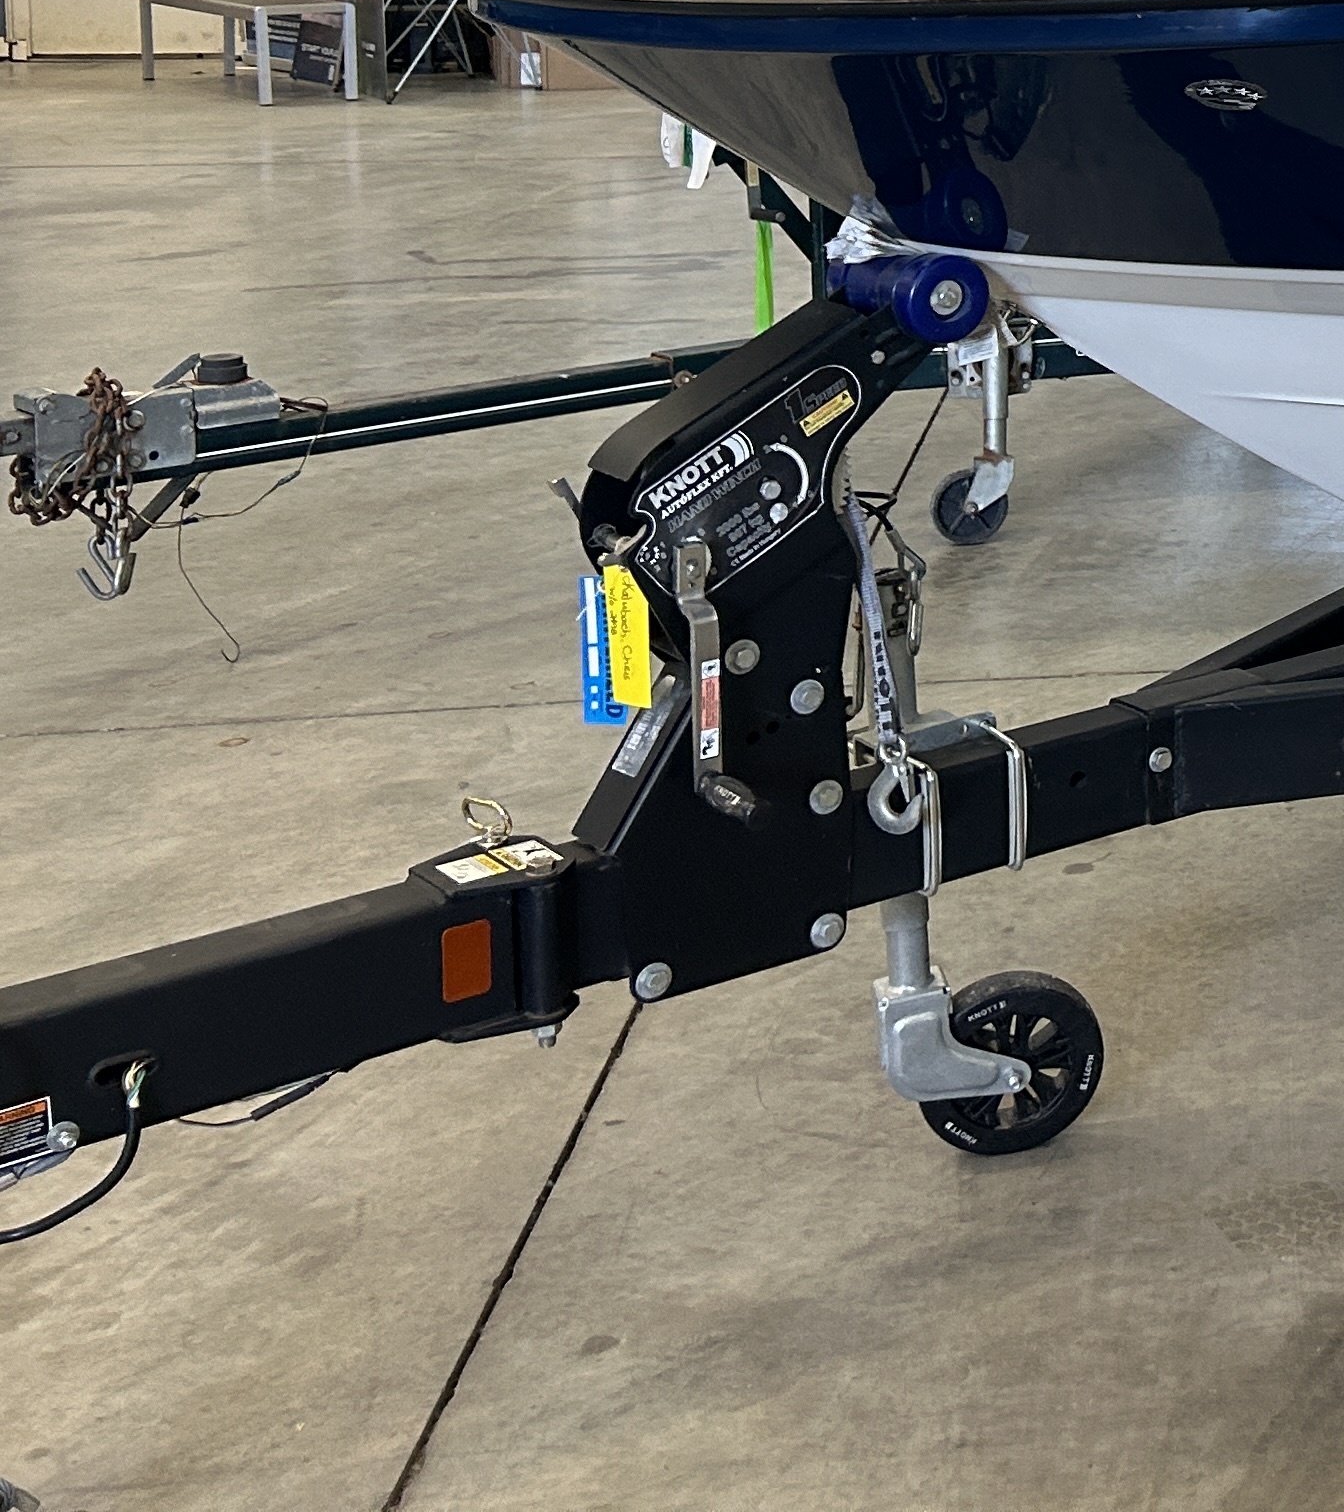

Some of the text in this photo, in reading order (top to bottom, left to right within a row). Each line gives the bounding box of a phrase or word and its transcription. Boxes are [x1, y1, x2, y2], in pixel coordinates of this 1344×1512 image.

[648, 444, 728, 510] KNOTT
[667, 457, 762, 534] HAND WINCH
[967, 1003, 999, 1023] KNOTT
[0, 1106, 36, 1122] ARNING
